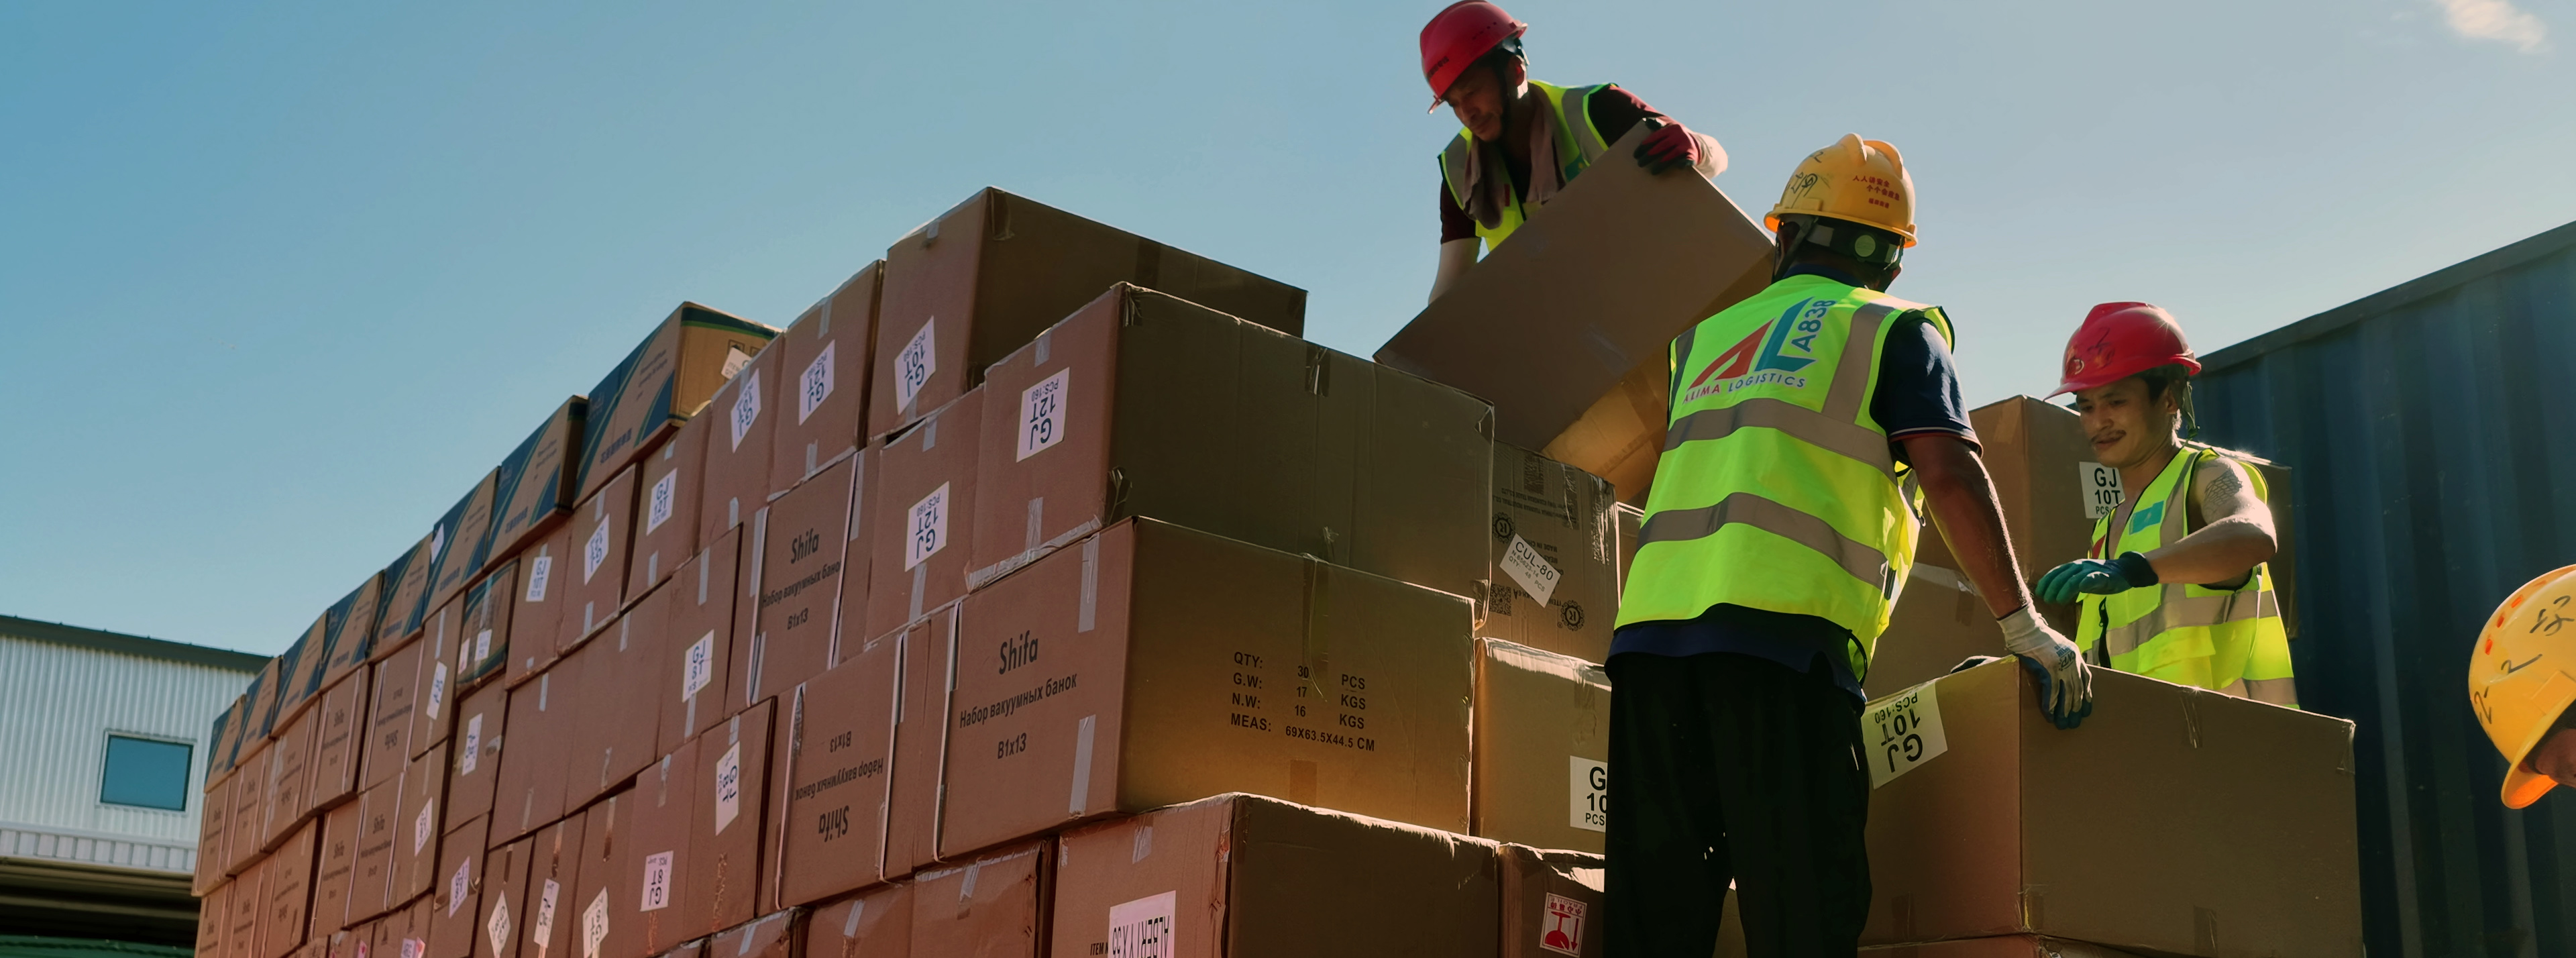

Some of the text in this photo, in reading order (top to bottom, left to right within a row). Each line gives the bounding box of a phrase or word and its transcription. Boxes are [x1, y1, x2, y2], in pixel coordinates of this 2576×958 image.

[1791, 300, 1837, 353] A838
[905, 345, 926, 379] 10T
[807, 363, 827, 391] 12T
[906, 364, 925, 397] GJ
[1728, 373, 1805, 392] LOGISTICS
[808, 382, 824, 412] GJ
[1682, 384, 1720, 405] ALIMA
[1030, 394, 1057, 423] 12T
[1030, 418, 1052, 450] GJ
[656, 477, 670, 500] GJ
[2094, 468, 2116, 488] GJ
[2094, 489, 2121, 504] 10T
[2095, 505, 2110, 515] PCS
[916, 511, 939, 535] 12T
[790, 528, 819, 565] Shifa
[916, 529, 936, 560] GJ
[822, 560, 841, 580] бано
[1515, 541, 1554, 580] CUL-80
[788, 607, 808, 630] B1x13
[693, 640, 706, 663] GJ
[999, 630, 1039, 676] Shifa
[1234, 651, 1365, 690] QTY: 30 PCS
[959, 673, 1078, 729] Набор вакуумных банок
[1233, 672, 1366, 710] G.W: 17 KGS
[1232, 692, 1364, 729] N.W: 16 KGS
[1874, 692, 1918, 724] PCS:160
[1231, 712, 1375, 751] MEAS: 69X63.5X44.5 CM
[1880, 708, 1921, 746] 10T
[830, 731, 851, 753] B1x13
[998, 733, 1027, 760] B1x13
[1886, 734, 1923, 774] GJ
[859, 757, 883, 778] Набор
[1590, 766, 1606, 790] G
[795, 783, 816, 800] банок
[1587, 792, 1608, 814] 10
[818, 805, 849, 843] Shifa
[1585, 812, 1605, 826] PCS
[651, 869, 663, 885] 8T
[649, 887, 662, 906] GJ
[1090, 942, 1104, 956] ITEM
